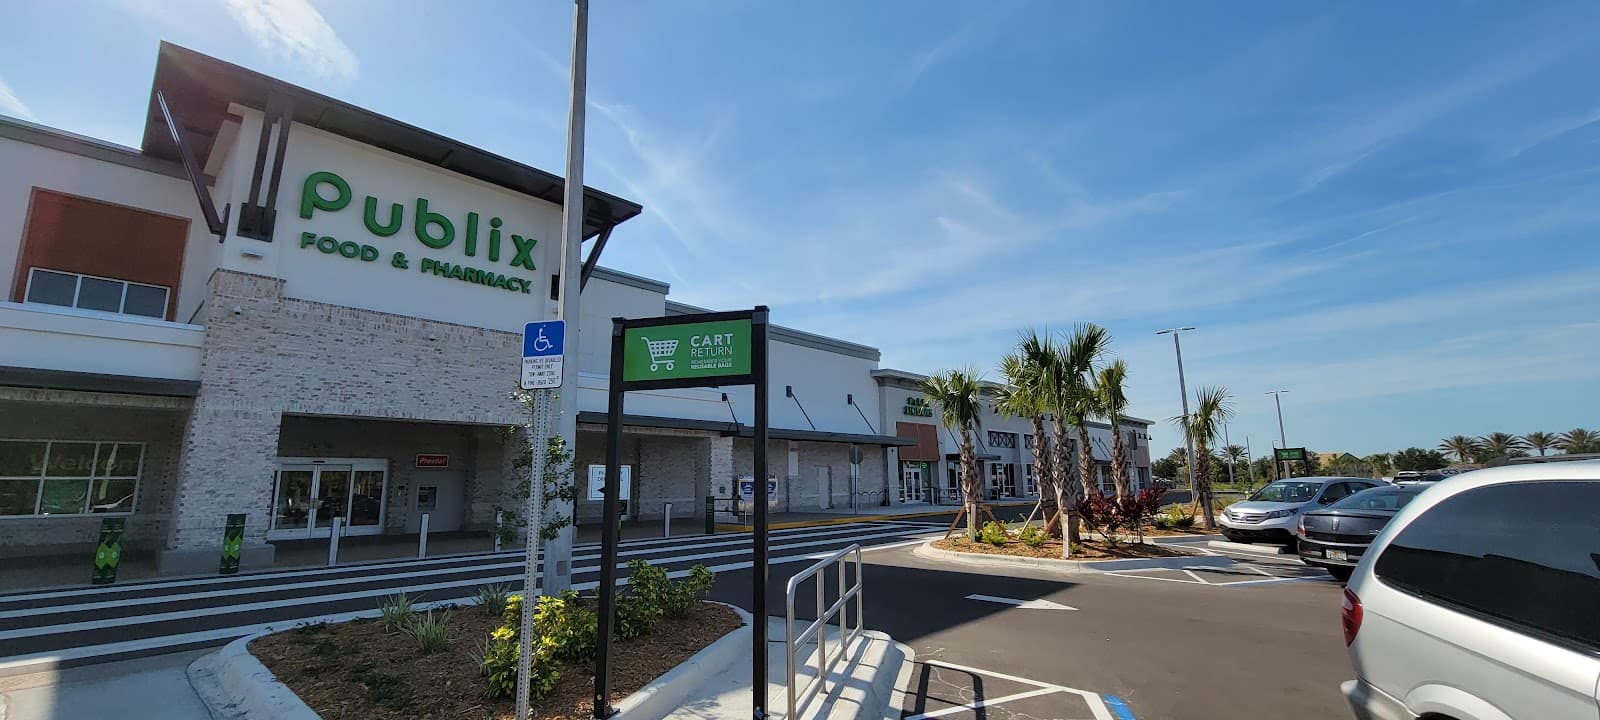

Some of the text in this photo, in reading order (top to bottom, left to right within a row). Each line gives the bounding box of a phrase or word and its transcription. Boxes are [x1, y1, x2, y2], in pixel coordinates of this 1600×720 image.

[300, 172, 537, 270] Publix
[300, 231, 532, 294] FOOD & PHARMACY
[690, 346, 732, 358] RETURN
[691, 334, 732, 347] CART
